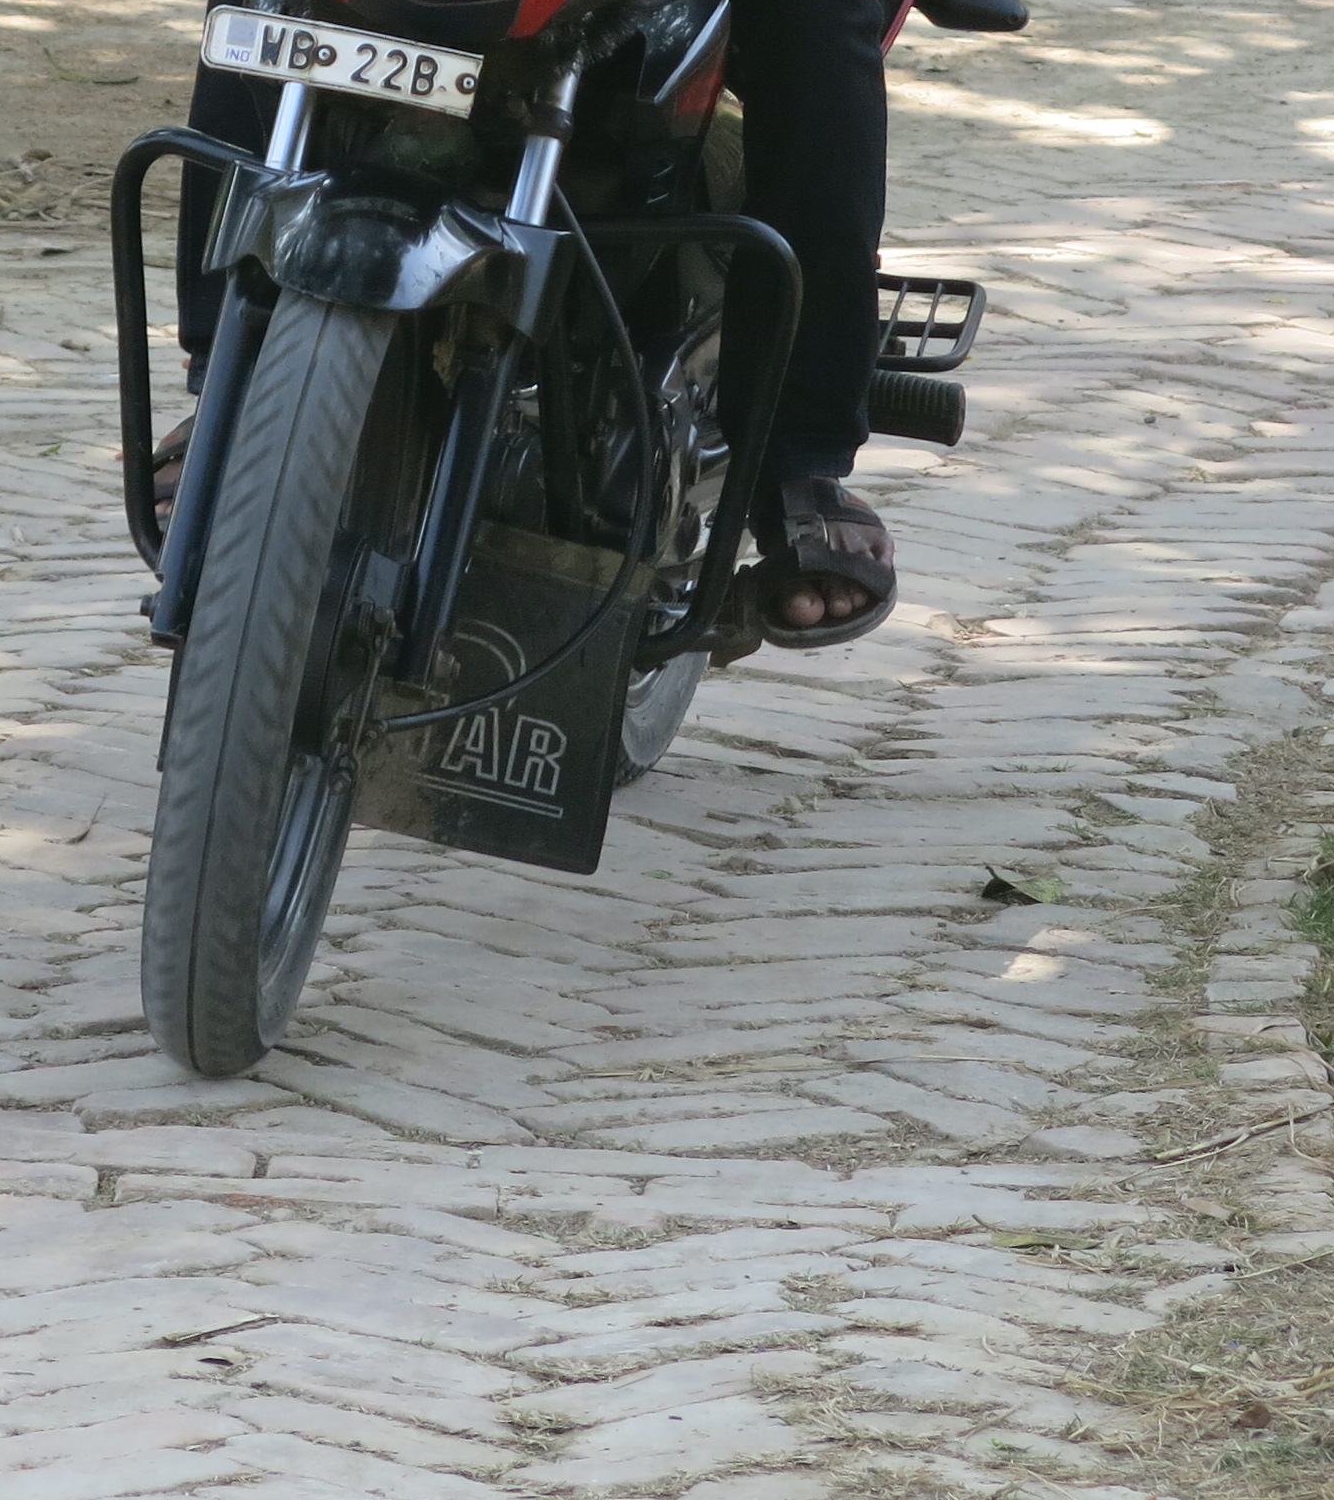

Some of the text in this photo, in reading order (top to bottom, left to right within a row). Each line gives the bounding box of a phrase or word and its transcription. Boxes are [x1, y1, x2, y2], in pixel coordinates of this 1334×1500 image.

[224, 47, 252, 63] IND
[259, 23, 439, 96] WB 22B
